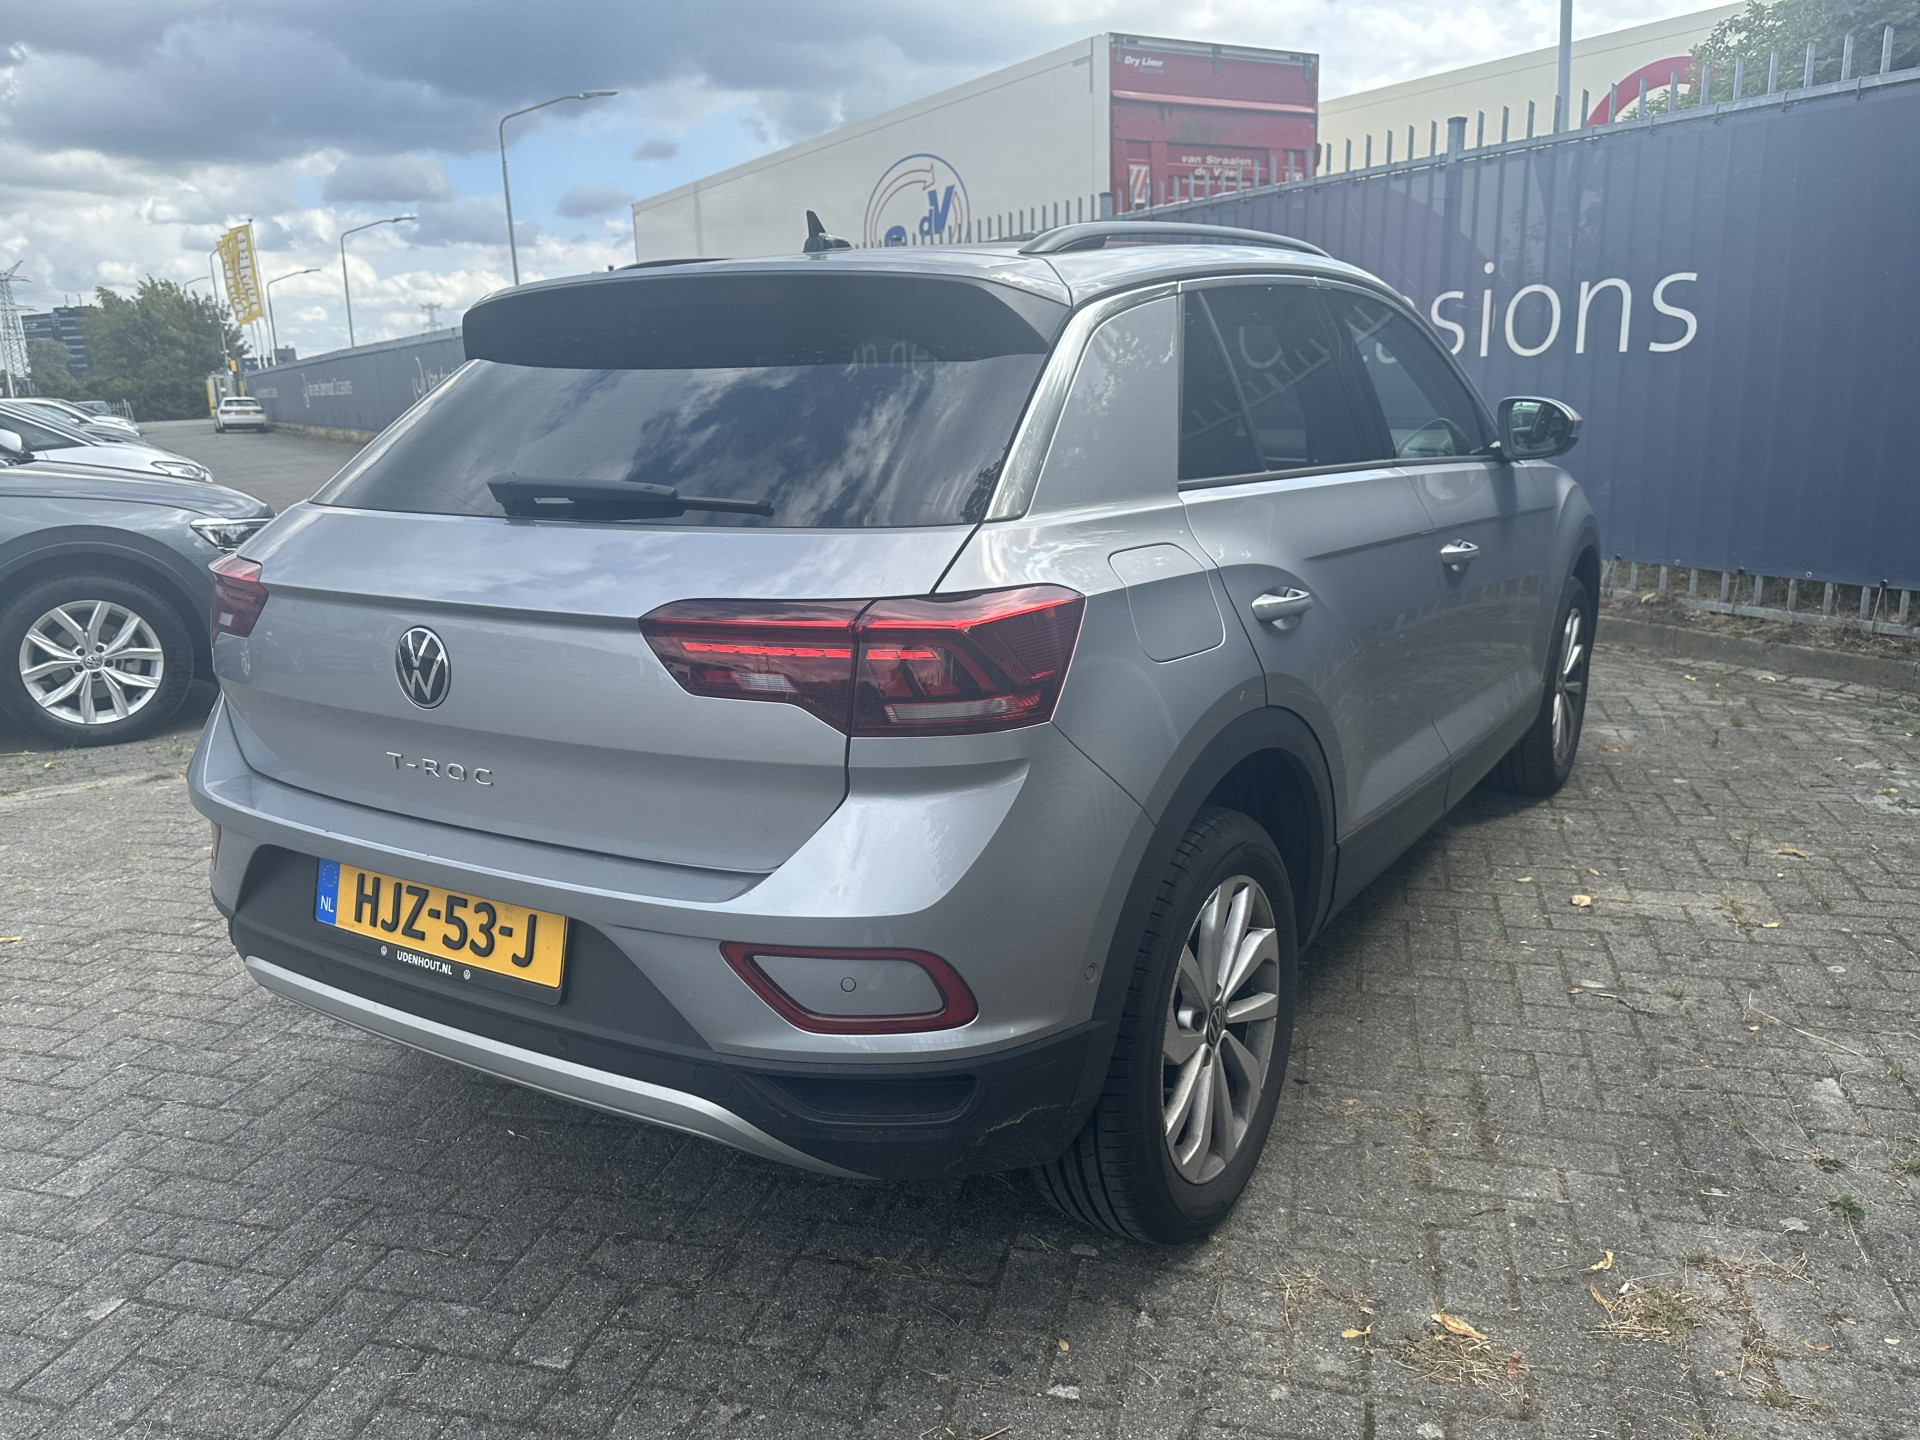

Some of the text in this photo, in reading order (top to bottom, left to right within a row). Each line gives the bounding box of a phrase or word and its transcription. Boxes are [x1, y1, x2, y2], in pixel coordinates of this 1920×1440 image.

[1124, 56, 1164, 67] Dry Liner
[1181, 156, 1202, 164] van
[1403, 261, 1698, 358] sions
[386, 751, 493, 786] T-ROC
[320, 895, 334, 914] NL
[354, 872, 538, 968] HJZ-53-J
[396, 950, 453, 976] UDENHOUT.NL
